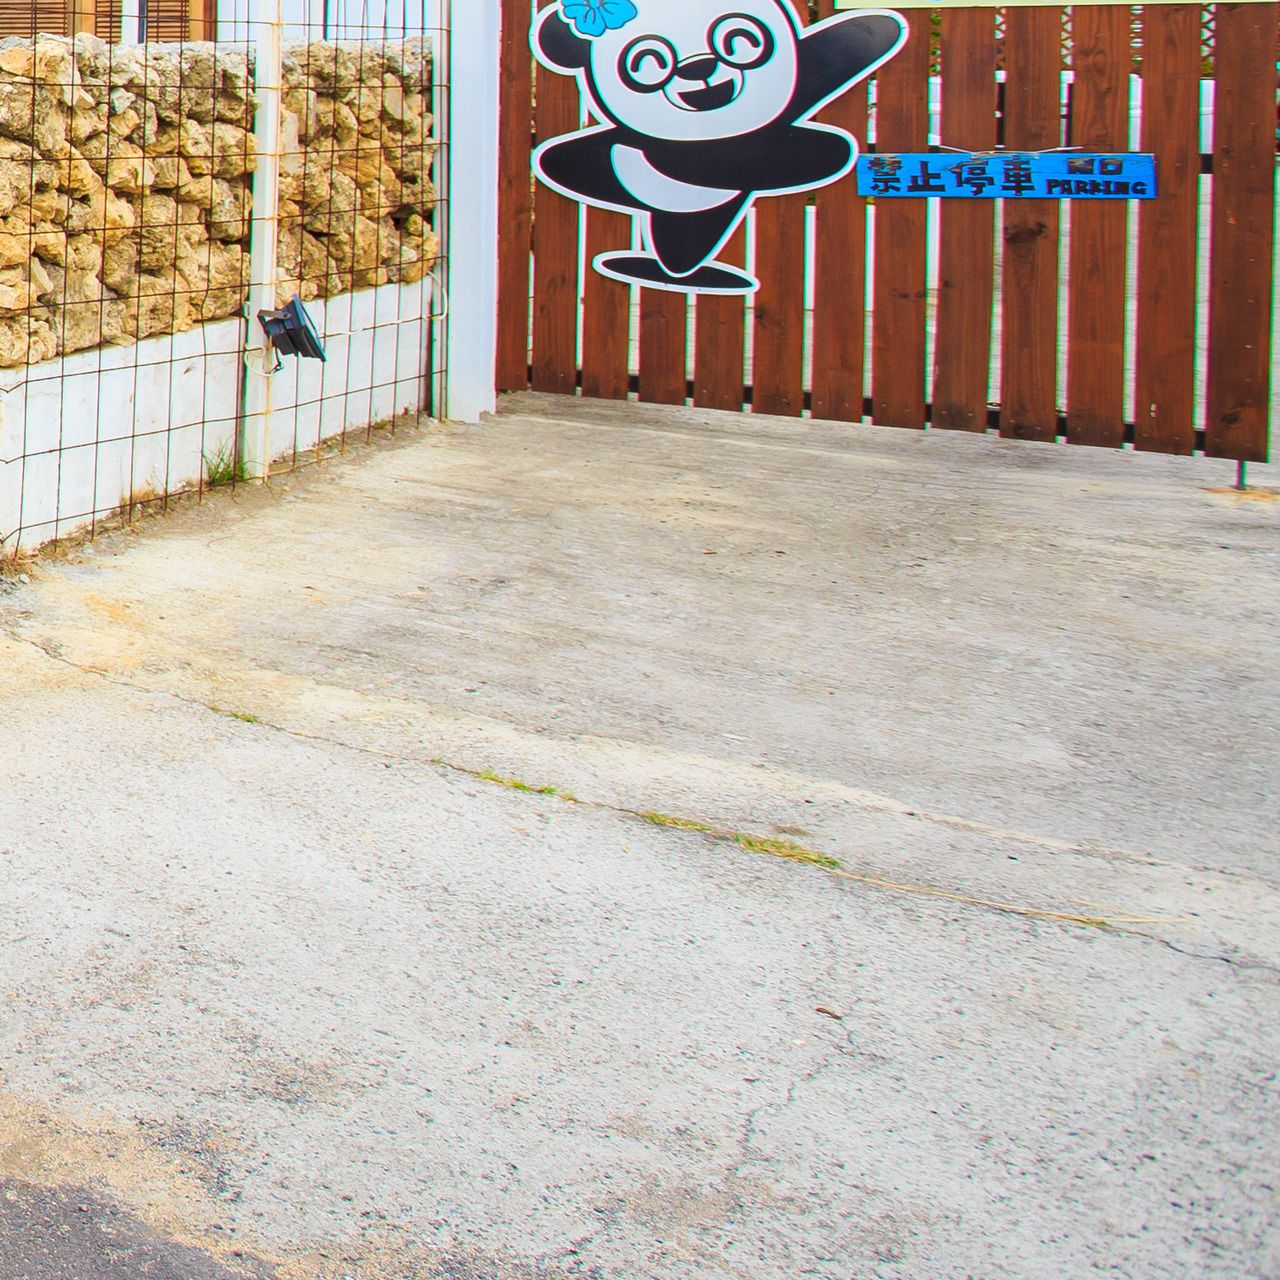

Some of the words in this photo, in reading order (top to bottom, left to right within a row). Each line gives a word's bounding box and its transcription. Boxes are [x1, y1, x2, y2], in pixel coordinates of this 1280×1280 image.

[1066, 157, 1123, 175] NO
[867, 156, 1035, 196] 禁止停車
[1045, 178, 1148, 195] PARKING
